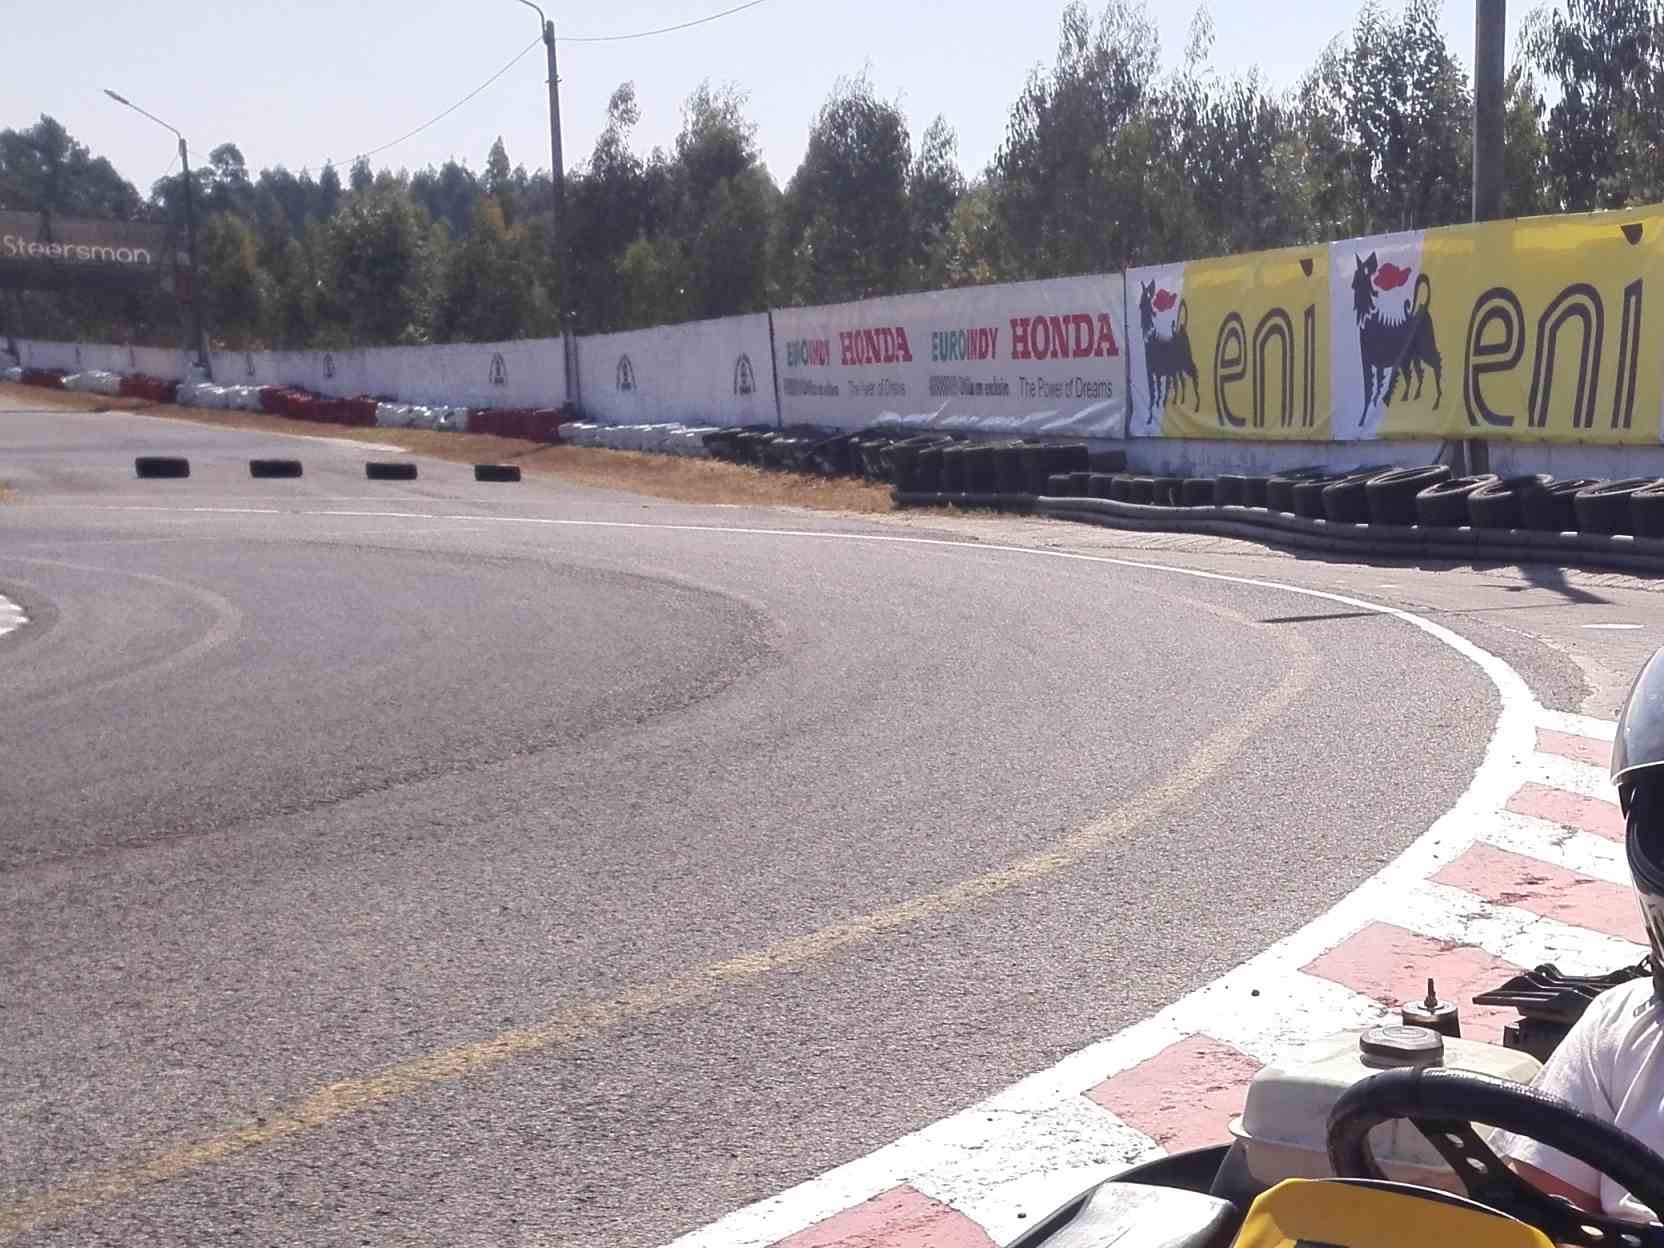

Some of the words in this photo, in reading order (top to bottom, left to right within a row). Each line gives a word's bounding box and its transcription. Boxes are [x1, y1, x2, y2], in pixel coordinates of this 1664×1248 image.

[839, 327, 913, 366] HONDA
[1009, 313, 1120, 360] HONDA
[1213, 258, 1317, 429] eni
[1464, 222, 1644, 429] eni
[1019, 376, 1037, 399] The
[1038, 377, 1064, 399] Poer
[1065, 378, 1074, 399] of
[1075, 376, 1113, 399] Dreams
